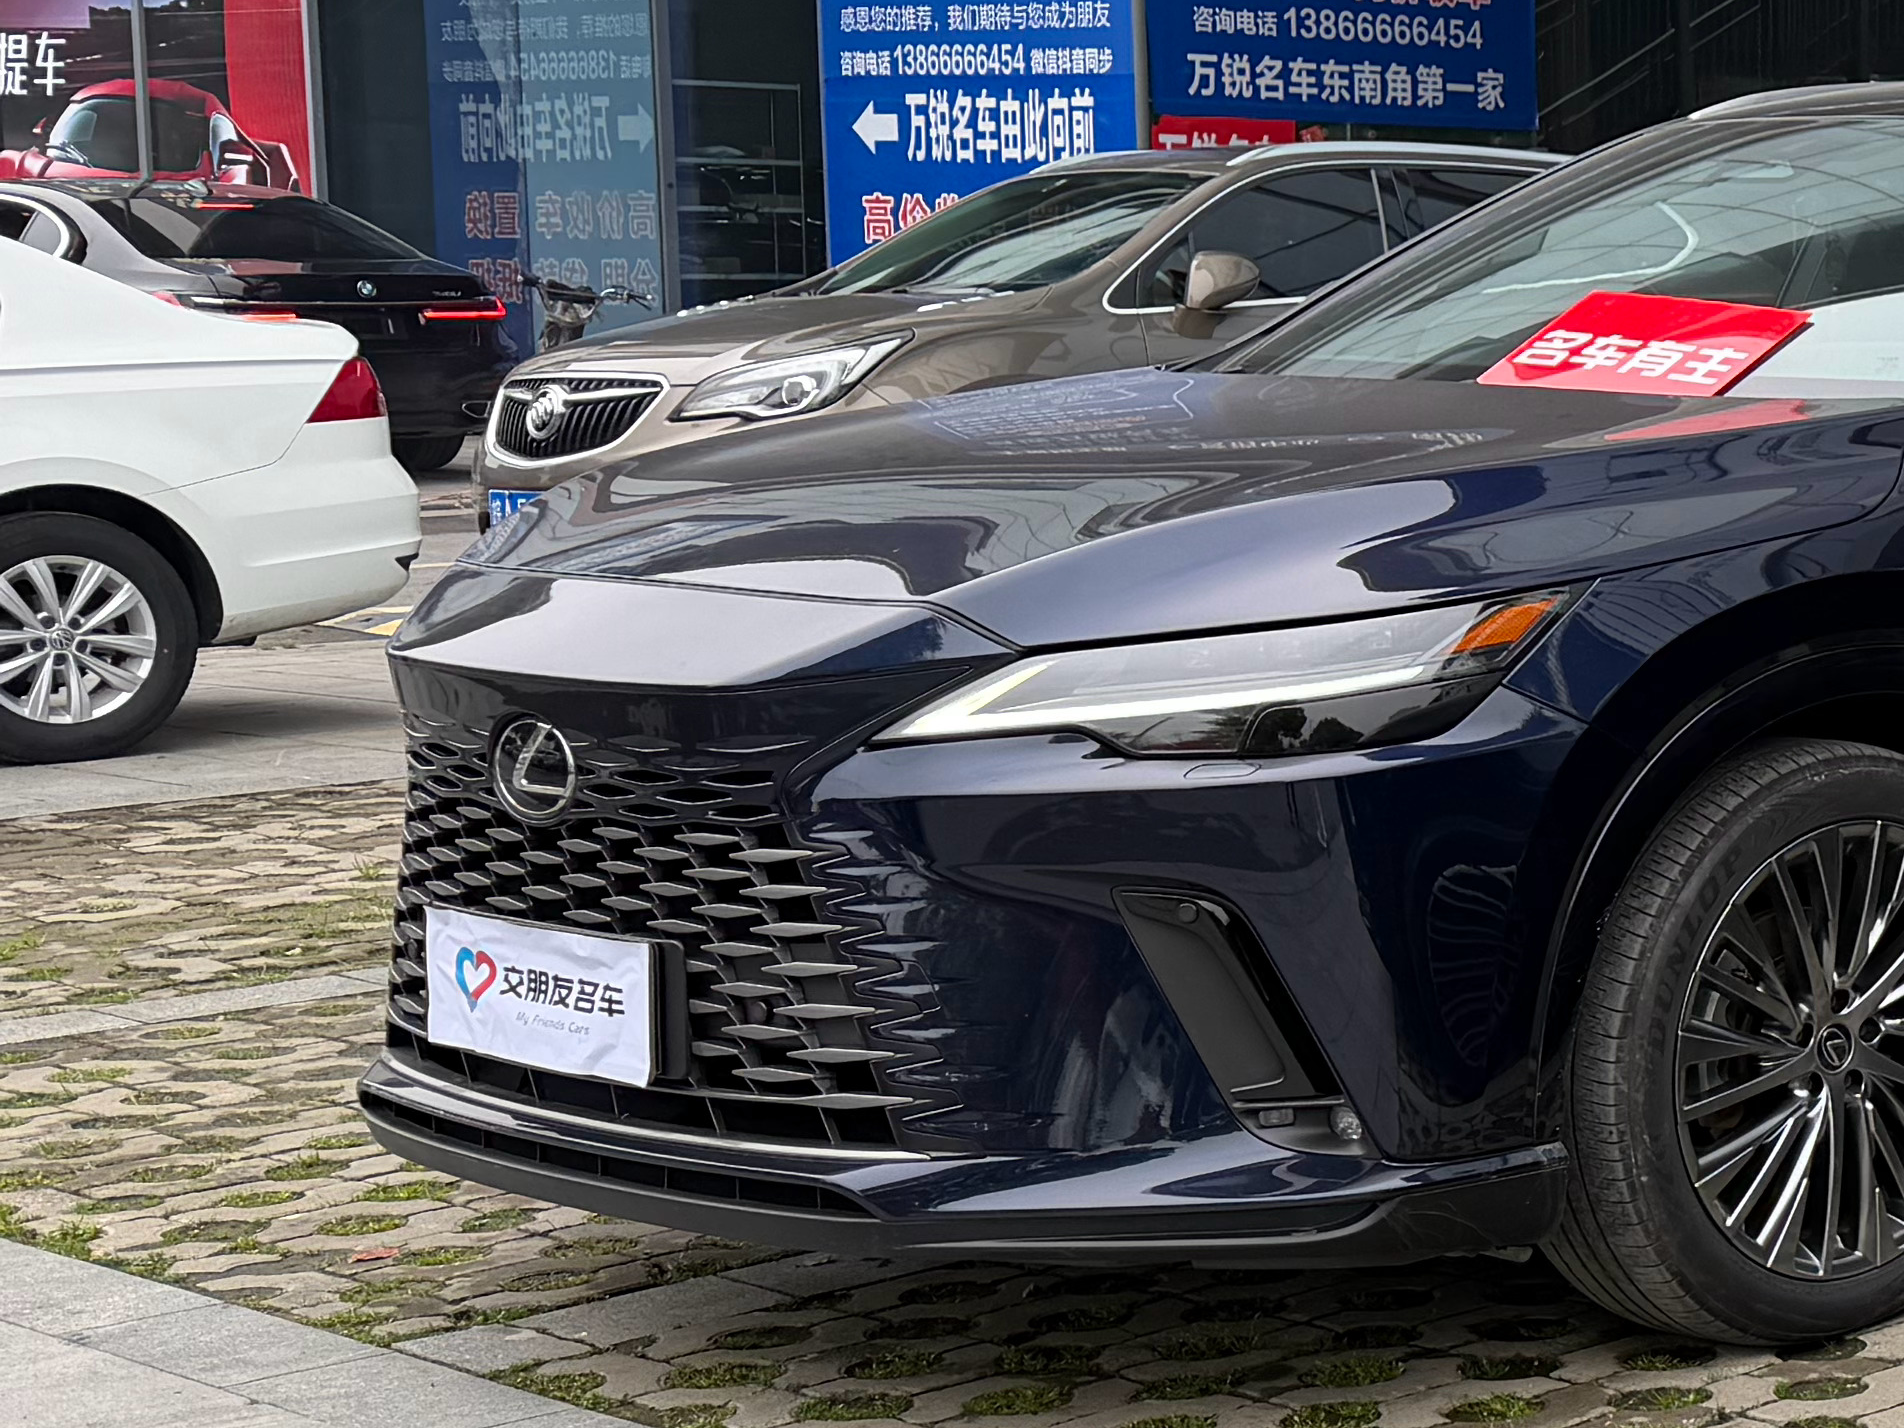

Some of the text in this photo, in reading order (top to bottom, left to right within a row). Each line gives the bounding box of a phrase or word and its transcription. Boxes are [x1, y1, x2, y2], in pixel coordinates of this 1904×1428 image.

[1193, 5, 1484, 50] 咨询电话 13866666454
[840, 50, 891, 76] 咨询电话
[893, 43, 1025, 76] 13866666454
[1187, 53, 1505, 112] 万锐名车东南角第一家
[904, 87, 1096, 165] 万锐名车由此向前
[862, 192, 958, 244] 高价
[1512, 329, 1749, 385] 名车有主
[499, 966, 625, 1018] 交朋友名车
